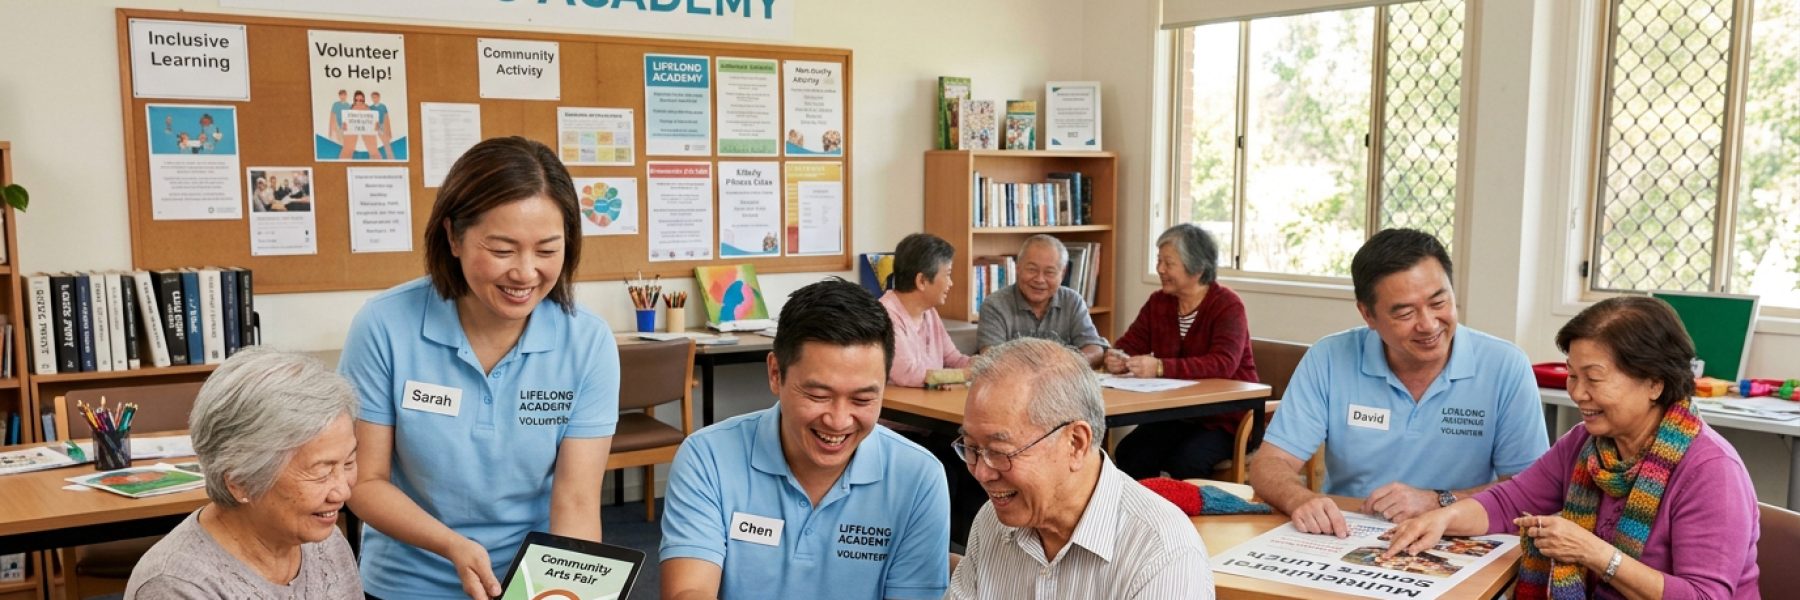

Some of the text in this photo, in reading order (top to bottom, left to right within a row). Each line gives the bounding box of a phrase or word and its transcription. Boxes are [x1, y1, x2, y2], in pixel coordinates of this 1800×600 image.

[148, 31, 230, 48] Inclusive
[315, 42, 399, 60] Volunteer
[151, 51, 230, 72] Learning
[324, 64, 392, 83] to Help!
[652, 72, 703, 83] ACADEMY
[412, 389, 452, 407] Sarah
[520, 390, 574, 401] LIFELONG
[1353, 410, 1385, 424] David
[738, 521, 773, 537] Chen
[541, 553, 612, 576] Community
[544, 568, 598, 585] Arts Fair
